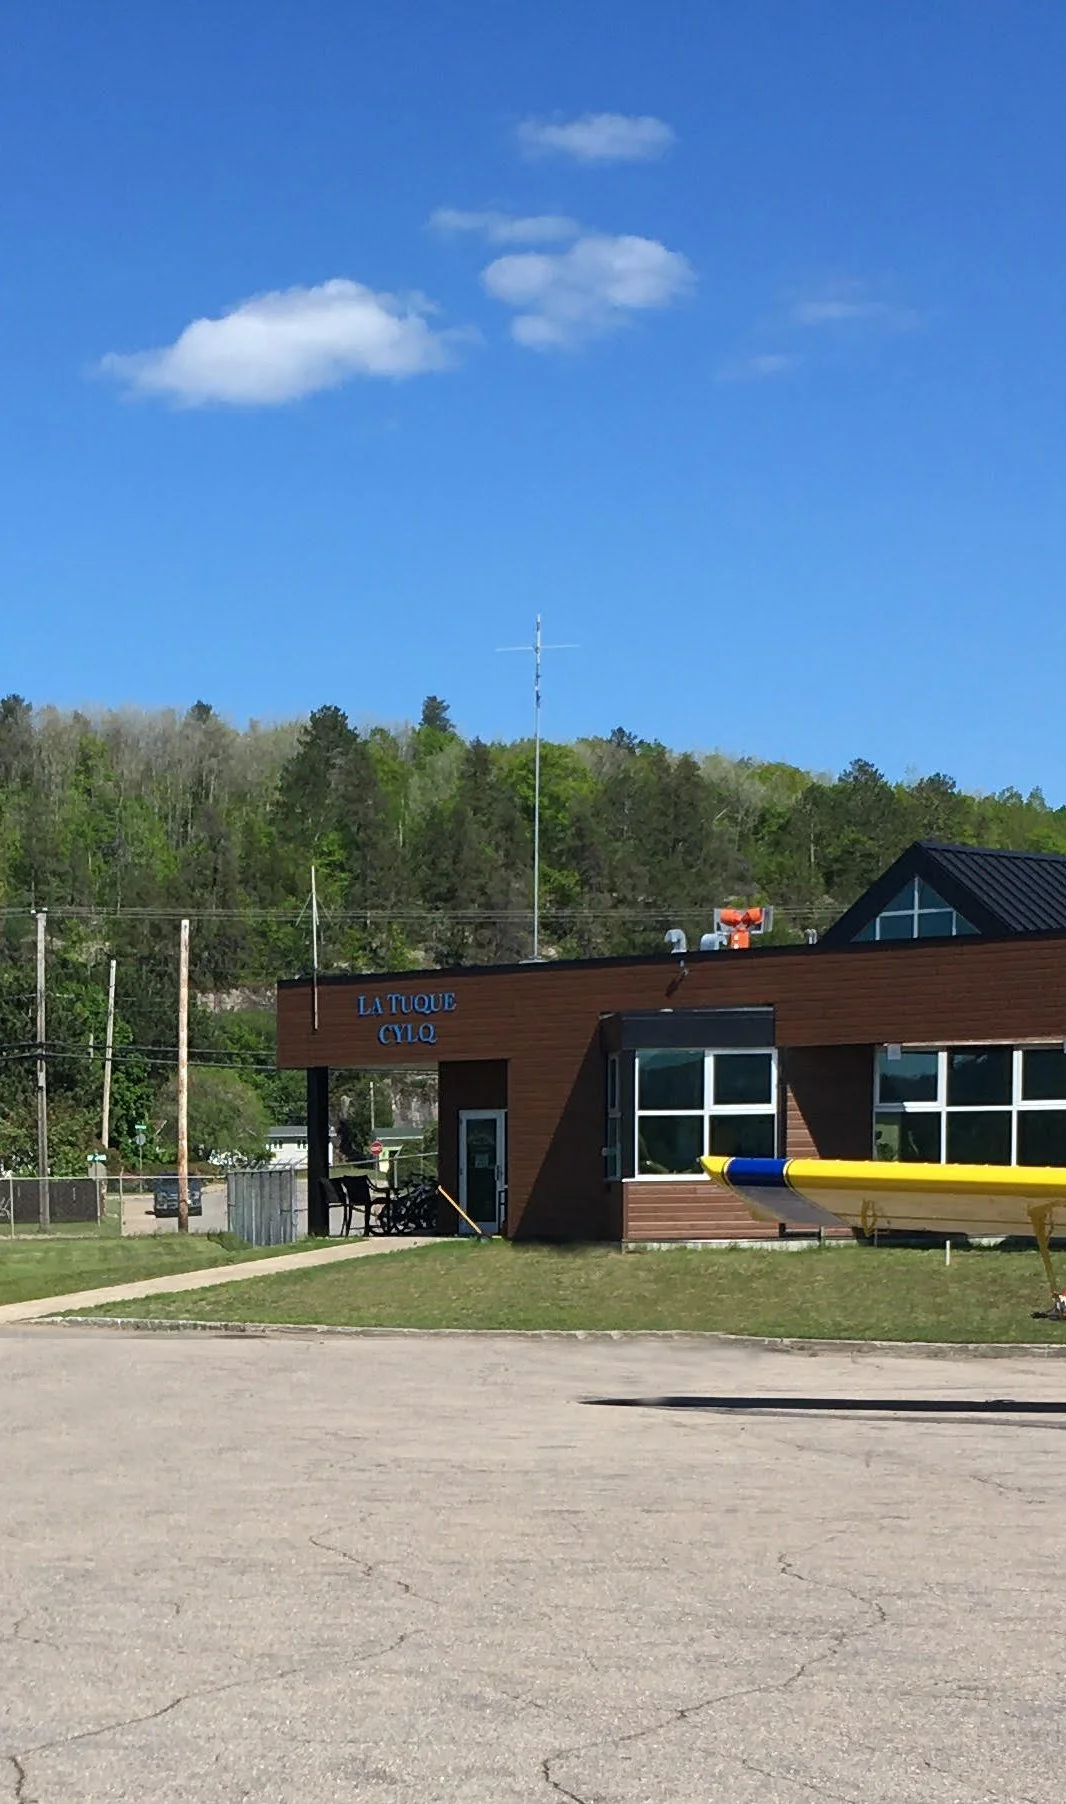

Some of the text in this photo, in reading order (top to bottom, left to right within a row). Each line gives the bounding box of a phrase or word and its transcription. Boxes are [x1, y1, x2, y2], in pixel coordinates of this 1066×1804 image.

[357, 991, 457, 1017] LA TUQUE
[378, 1022, 438, 1045] CYLQ
